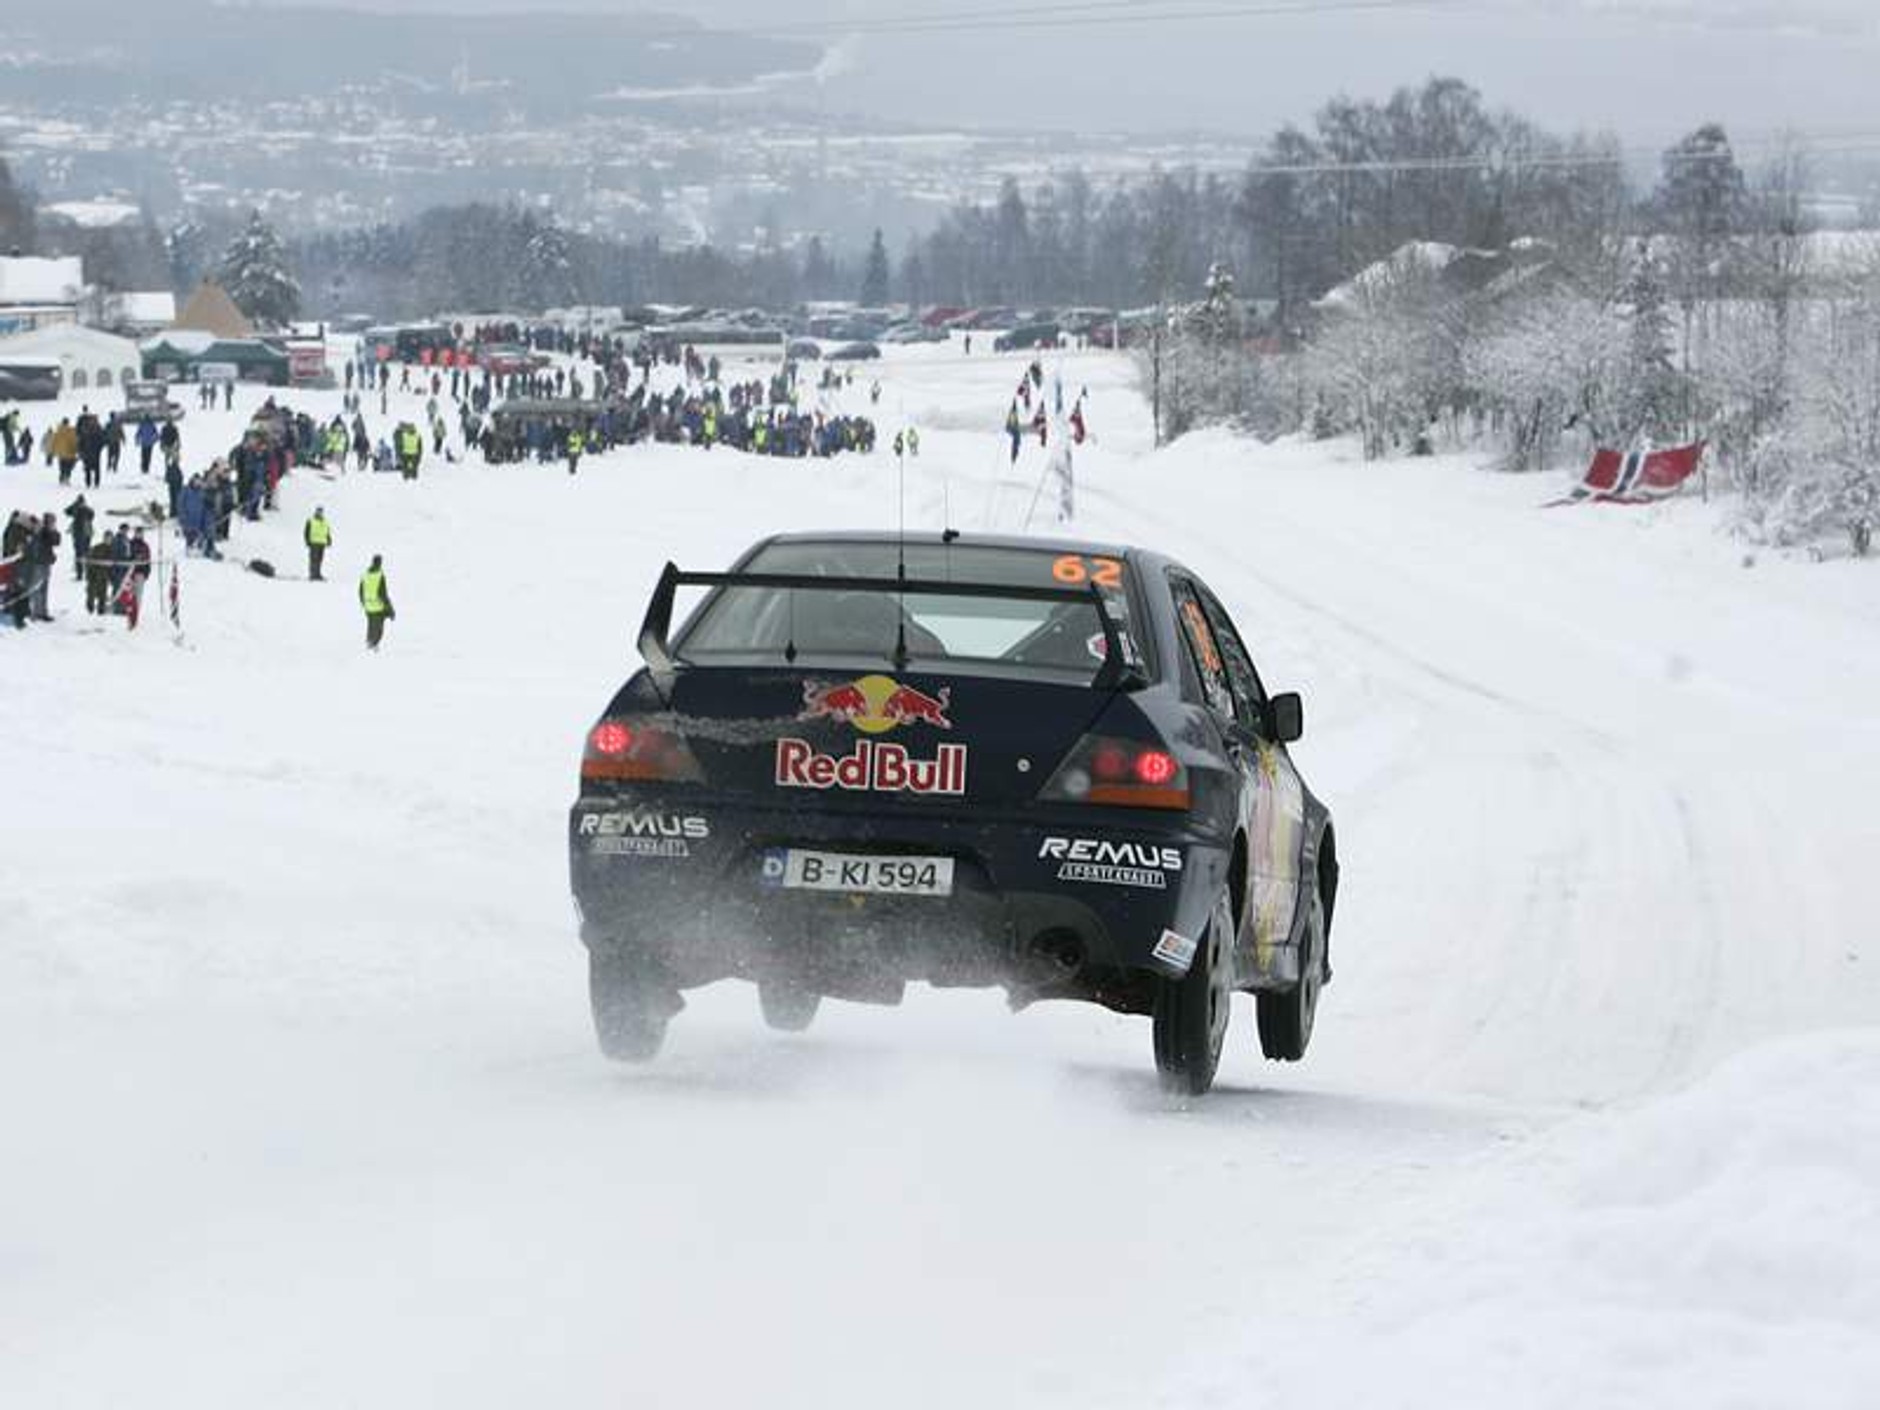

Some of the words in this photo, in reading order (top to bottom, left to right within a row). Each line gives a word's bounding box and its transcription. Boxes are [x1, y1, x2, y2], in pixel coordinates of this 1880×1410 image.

[1052, 554, 1122, 588] 62
[776, 738, 871, 790] Red
[874, 743, 967, 796] Bull
[580, 813, 709, 838] REMUS
[1038, 837, 1182, 870] REMUS
[877, 862, 938, 888] 594
